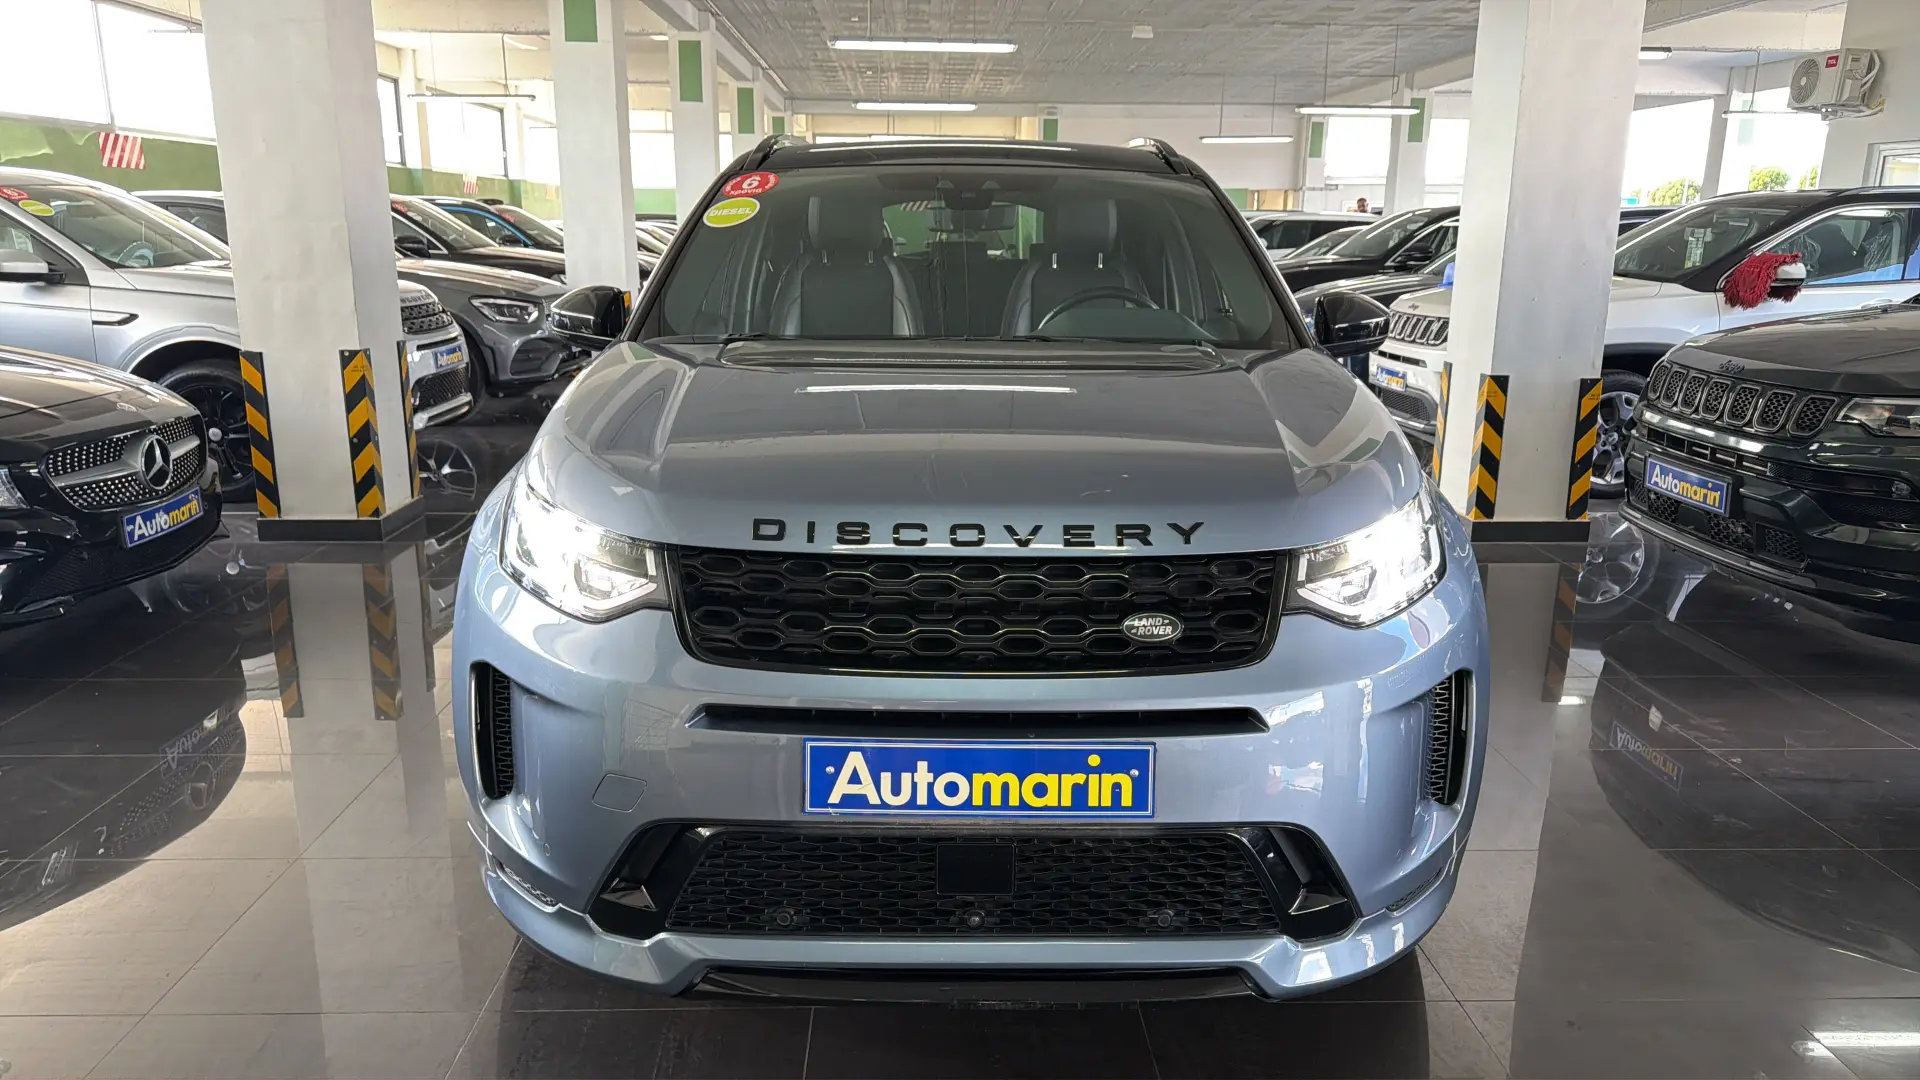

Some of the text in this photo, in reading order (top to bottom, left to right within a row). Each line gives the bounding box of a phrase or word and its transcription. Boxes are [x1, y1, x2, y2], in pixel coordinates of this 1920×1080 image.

[742, 175, 761, 189] 6
[708, 207, 752, 217] DIESEL
[1719, 360, 1745, 374] Jeep
[1651, 465, 1720, 508] Automarin
[134, 498, 200, 541] Automarin
[752, 517, 1204, 548] DISCOVERY
[1134, 617, 1162, 627] LAND
[1137, 626, 1173, 636] ROVER
[827, 751, 1132, 808] Automarin
